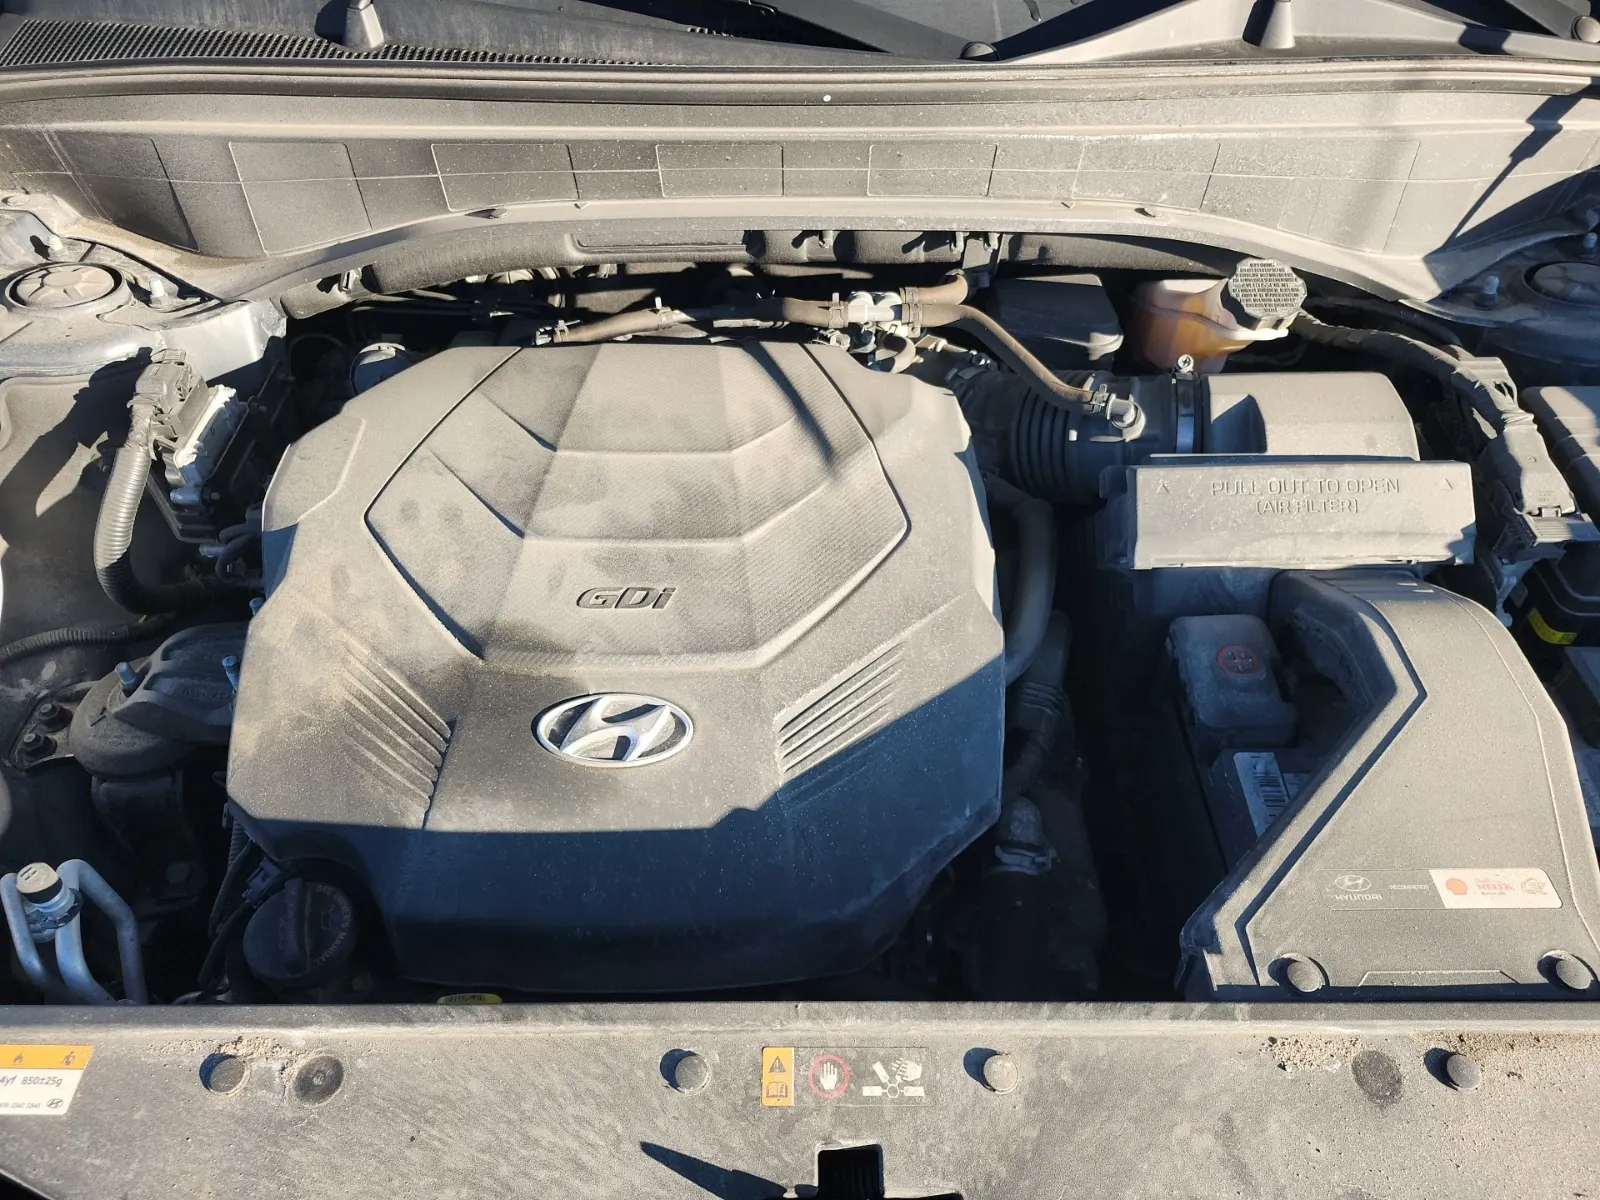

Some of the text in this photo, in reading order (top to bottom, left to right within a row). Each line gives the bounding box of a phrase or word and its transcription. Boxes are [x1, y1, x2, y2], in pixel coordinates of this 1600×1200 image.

[1211, 477, 1399, 495] PULL OUT TO OPEN
[1256, 498, 1358, 515] (AIR FILTER)
[576, 587, 676, 609] GDi
[1335, 893, 1383, 901] HYUNDAI
[21, 1076, 63, 1087] 850±25g
